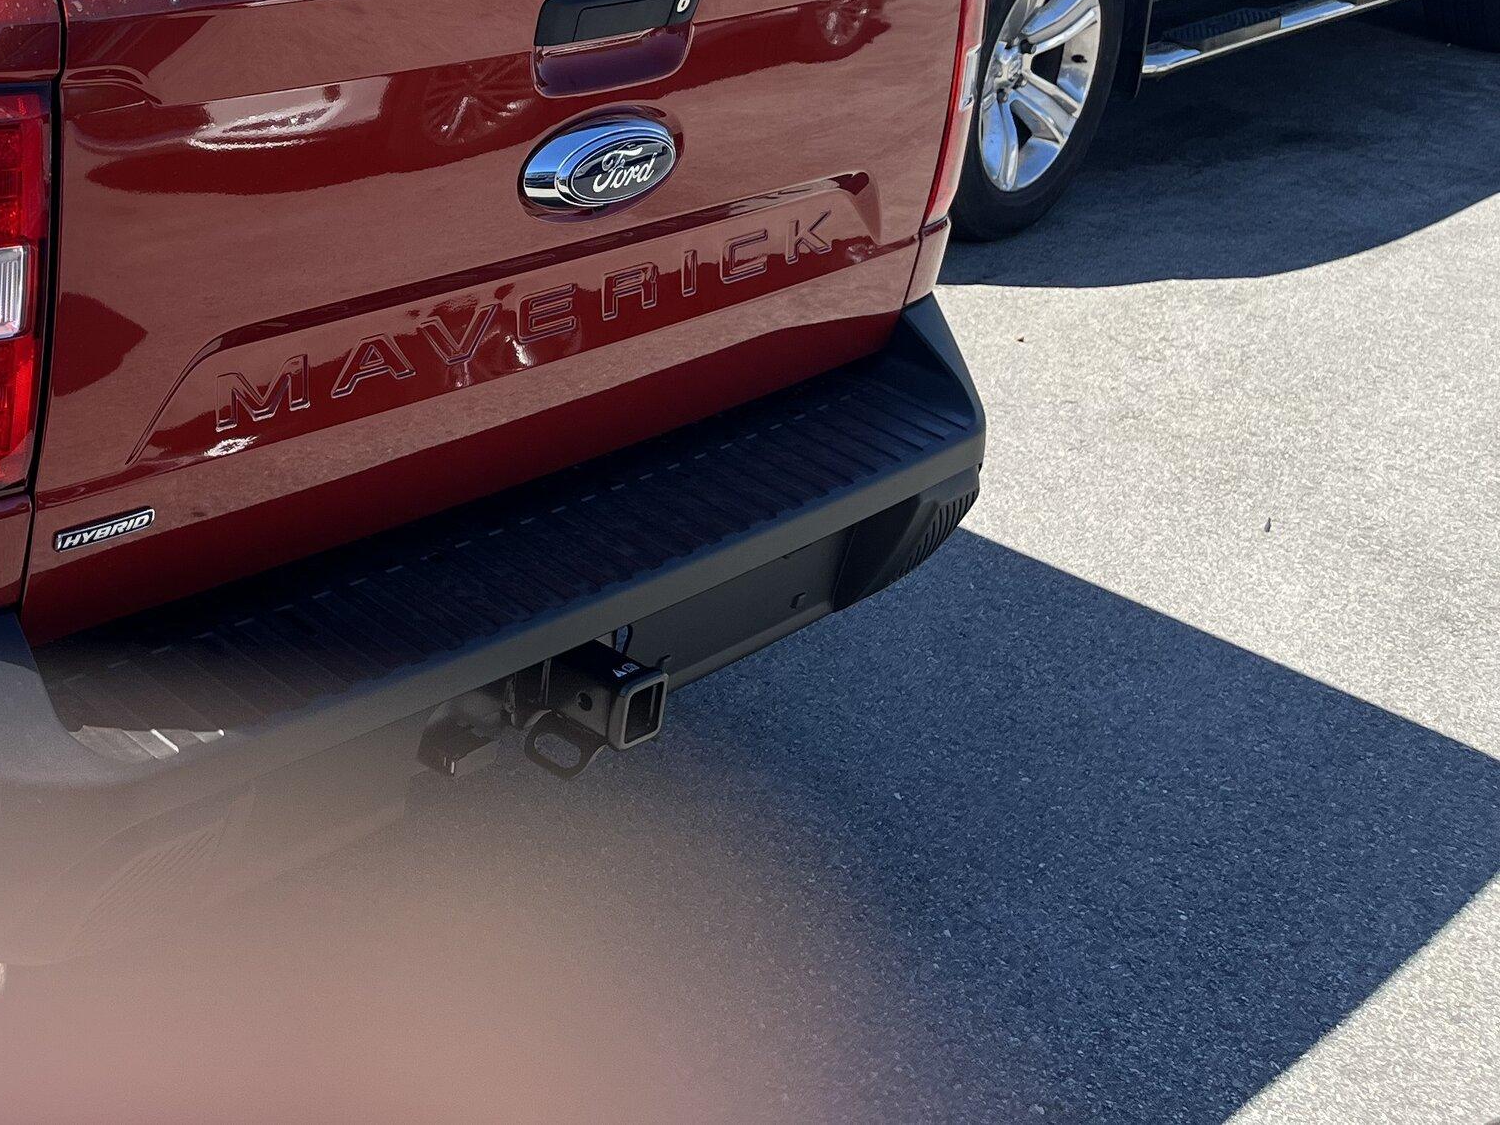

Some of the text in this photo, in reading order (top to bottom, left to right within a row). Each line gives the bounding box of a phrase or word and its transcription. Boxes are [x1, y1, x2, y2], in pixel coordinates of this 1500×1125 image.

[592, 146, 657, 193] Ford
[215, 208, 833, 433] MAVERICK
[61, 514, 150, 549] HYBRID
